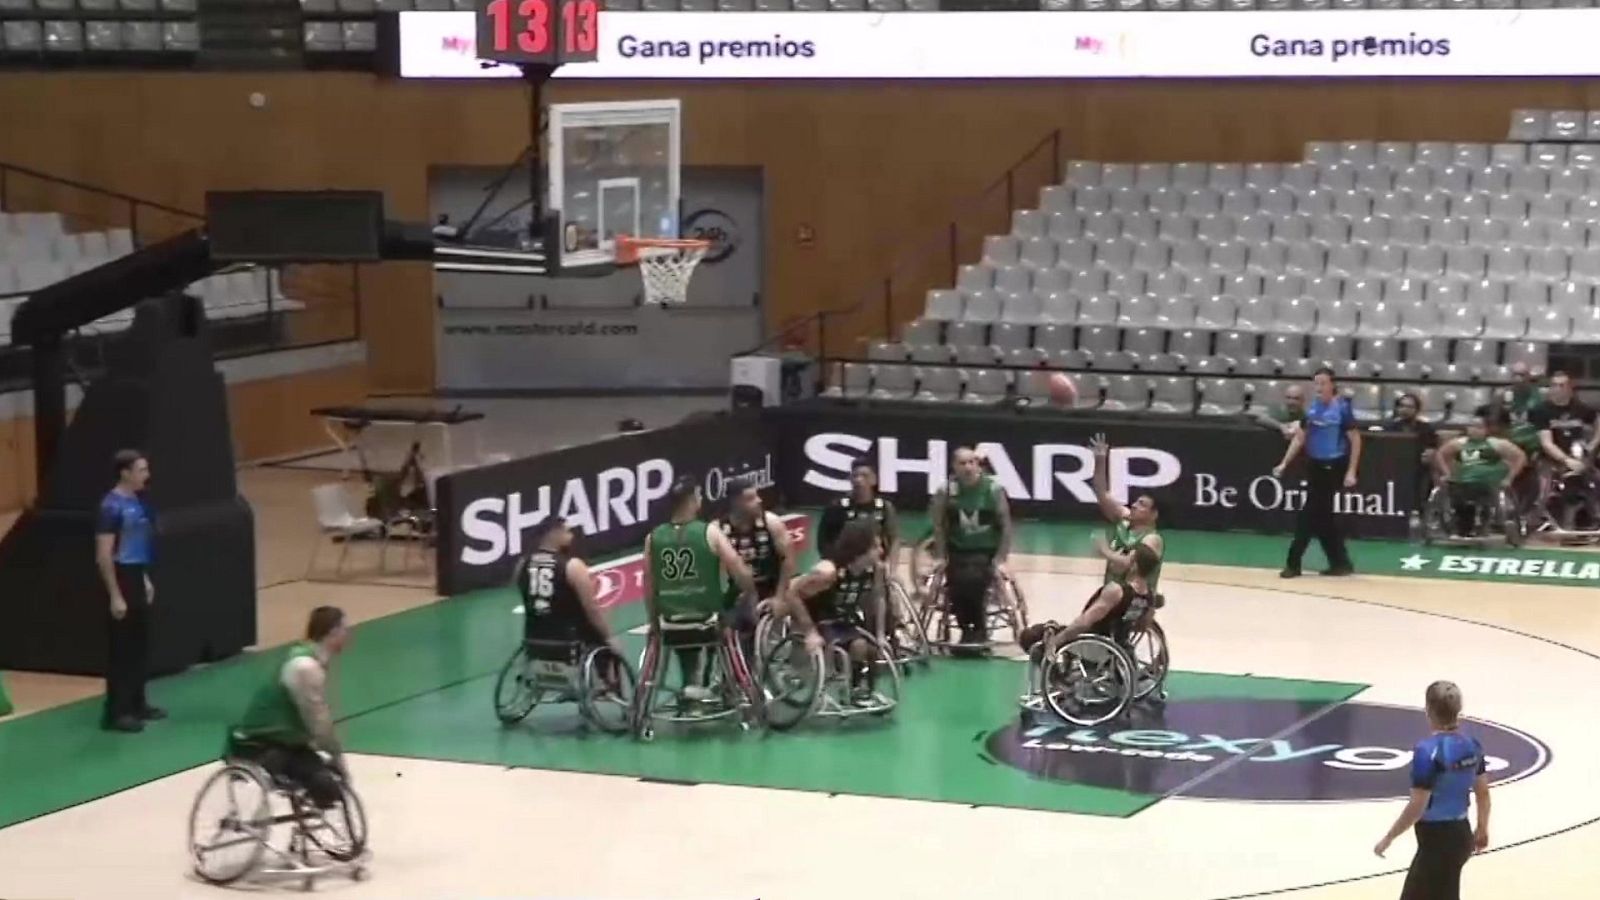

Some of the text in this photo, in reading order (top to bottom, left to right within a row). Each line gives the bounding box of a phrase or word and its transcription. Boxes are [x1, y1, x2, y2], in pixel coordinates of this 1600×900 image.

[486, 0, 549, 53] 13
[562, 0, 598, 53] 13
[617, 33, 816, 65] Gana premios
[1249, 32, 1451, 62] Gana premios
[803, 431, 1405, 517] SHARP Be Oriinal.
[460, 458, 675, 566] SHARP
[661, 547, 699, 580] 32
[1437, 554, 1600, 580] ESTRELLA
[527, 566, 555, 598] 16
